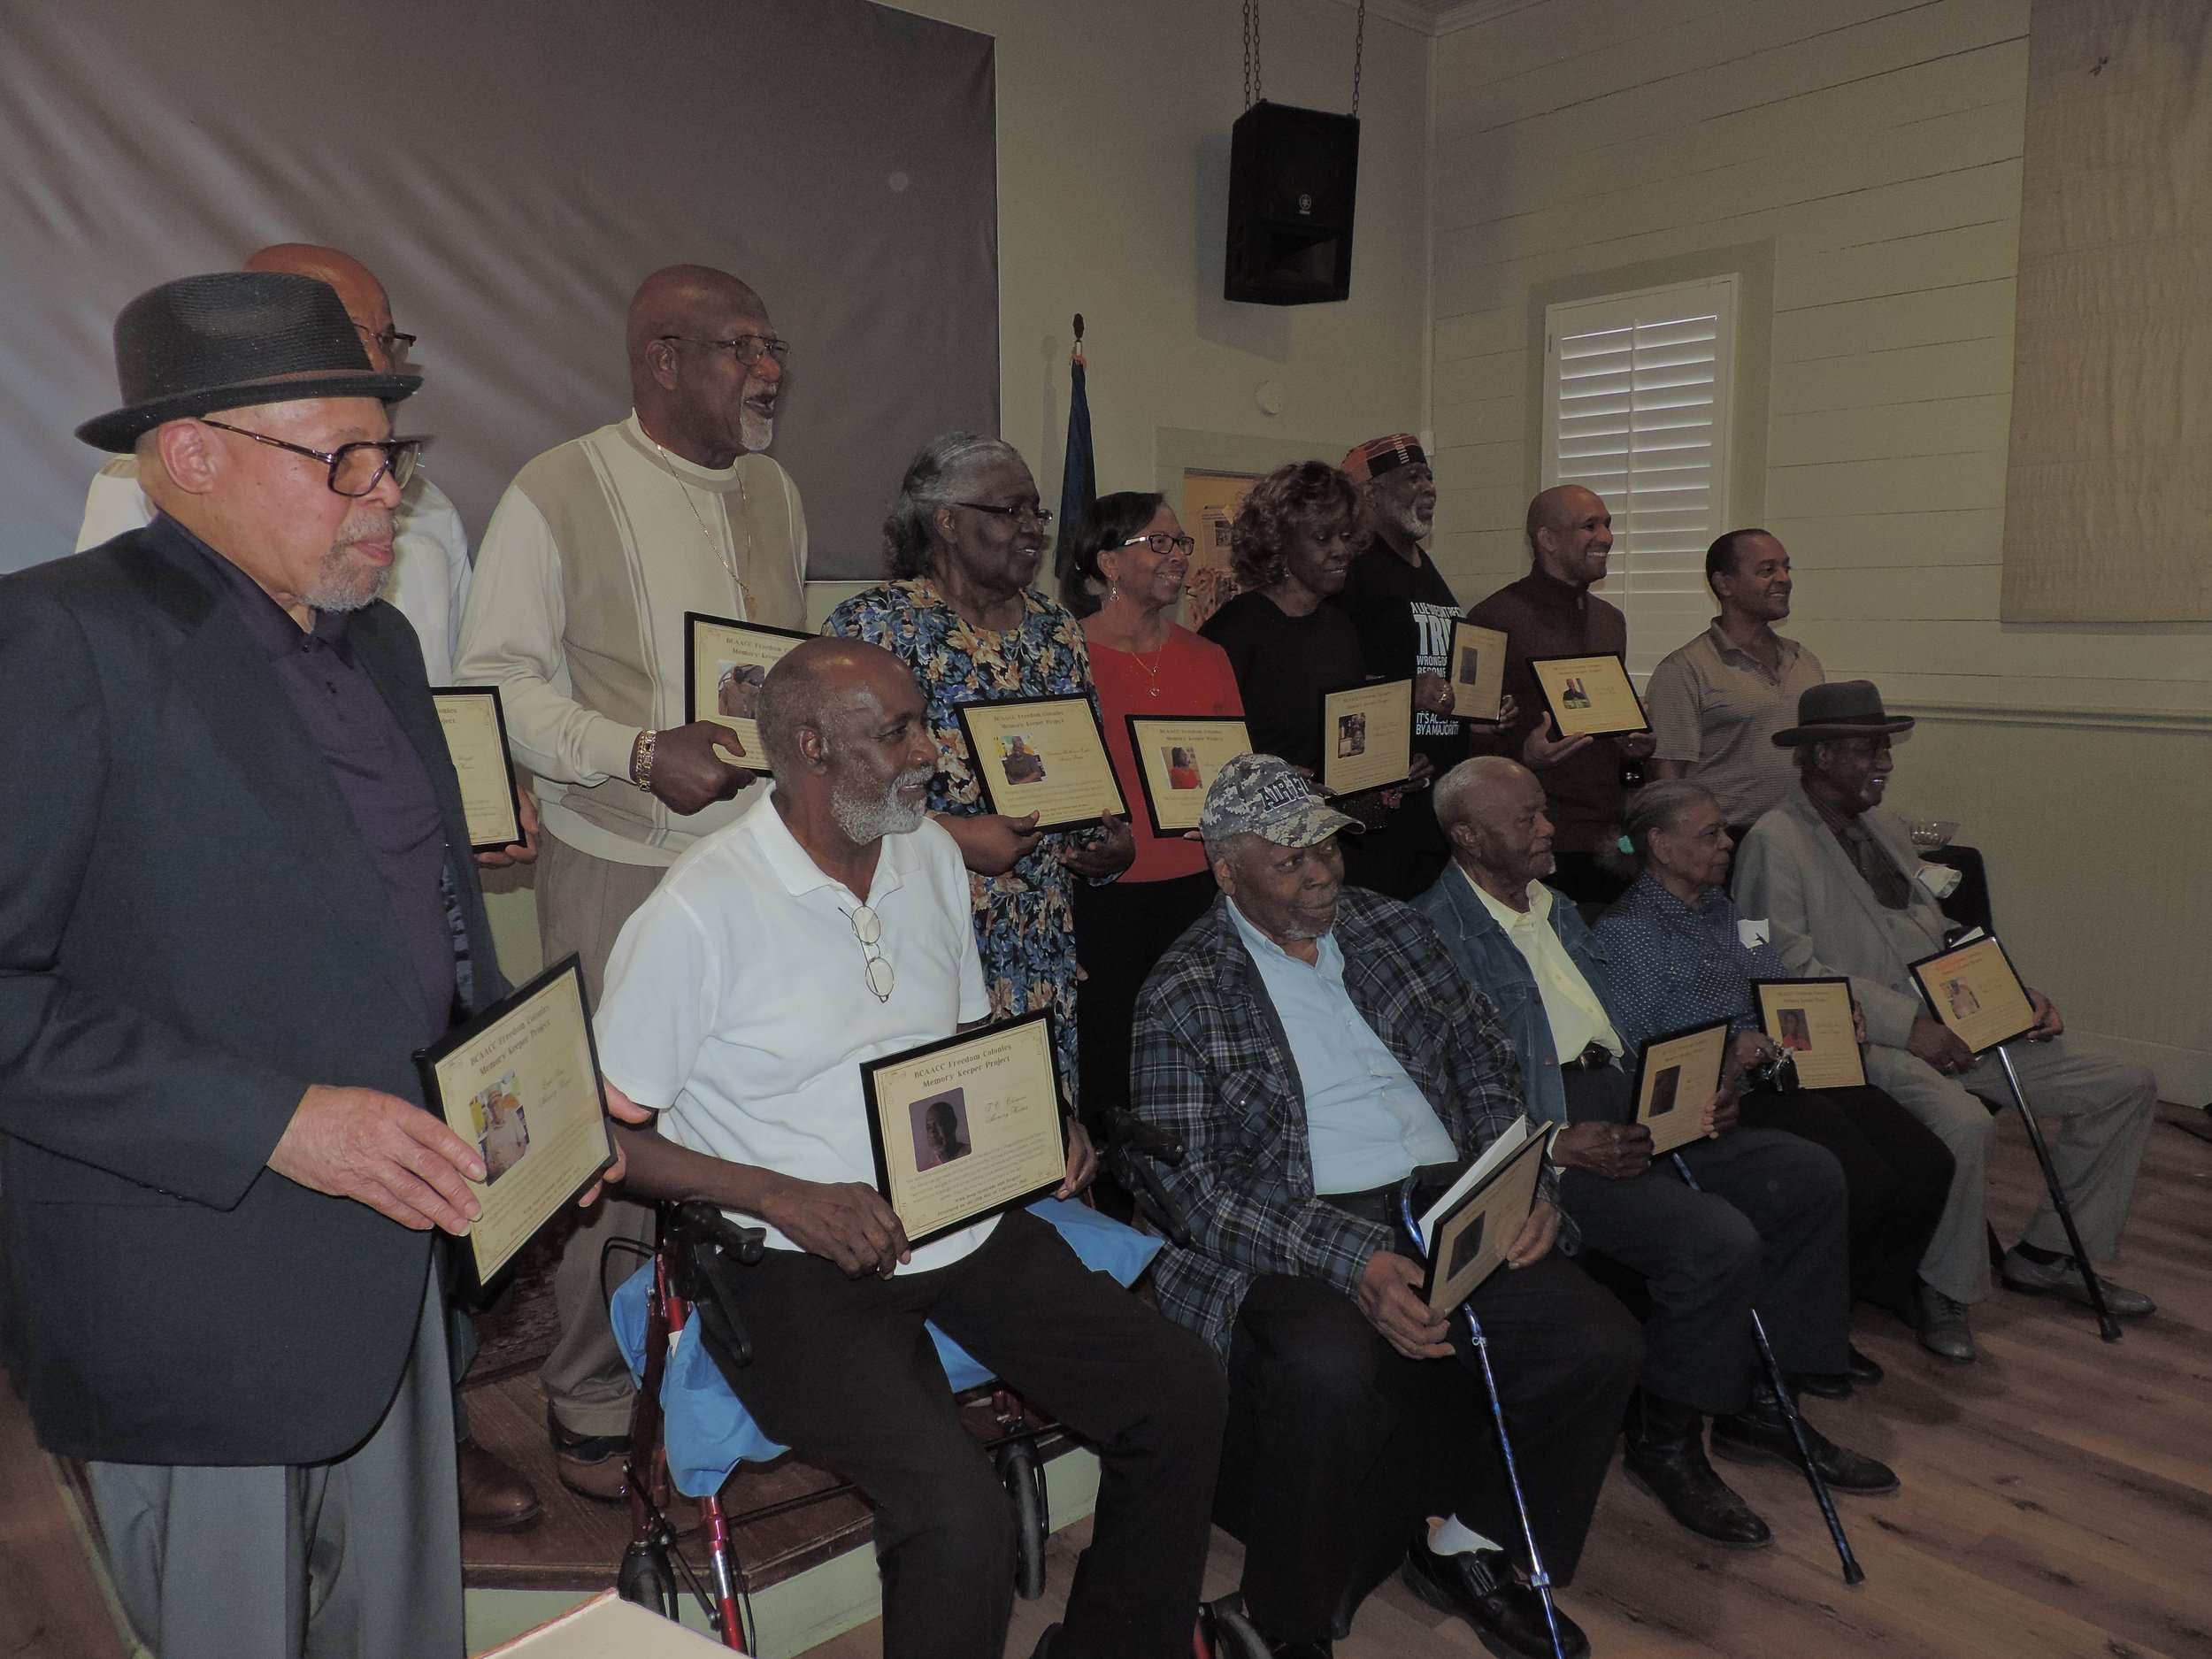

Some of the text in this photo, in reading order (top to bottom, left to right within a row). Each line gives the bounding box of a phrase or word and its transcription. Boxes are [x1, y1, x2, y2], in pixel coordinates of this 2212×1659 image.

[1416, 655, 1442, 666] WRONG
[1416, 724, 1425, 735] BY
[1425, 724, 1432, 735] A
[479, 1019, 550, 1076] Memory Keeper Project
[914, 1043, 1012, 1079] BCAACC Freedom Colonies
[923, 1056, 1010, 1088] Memory Keeper Project
